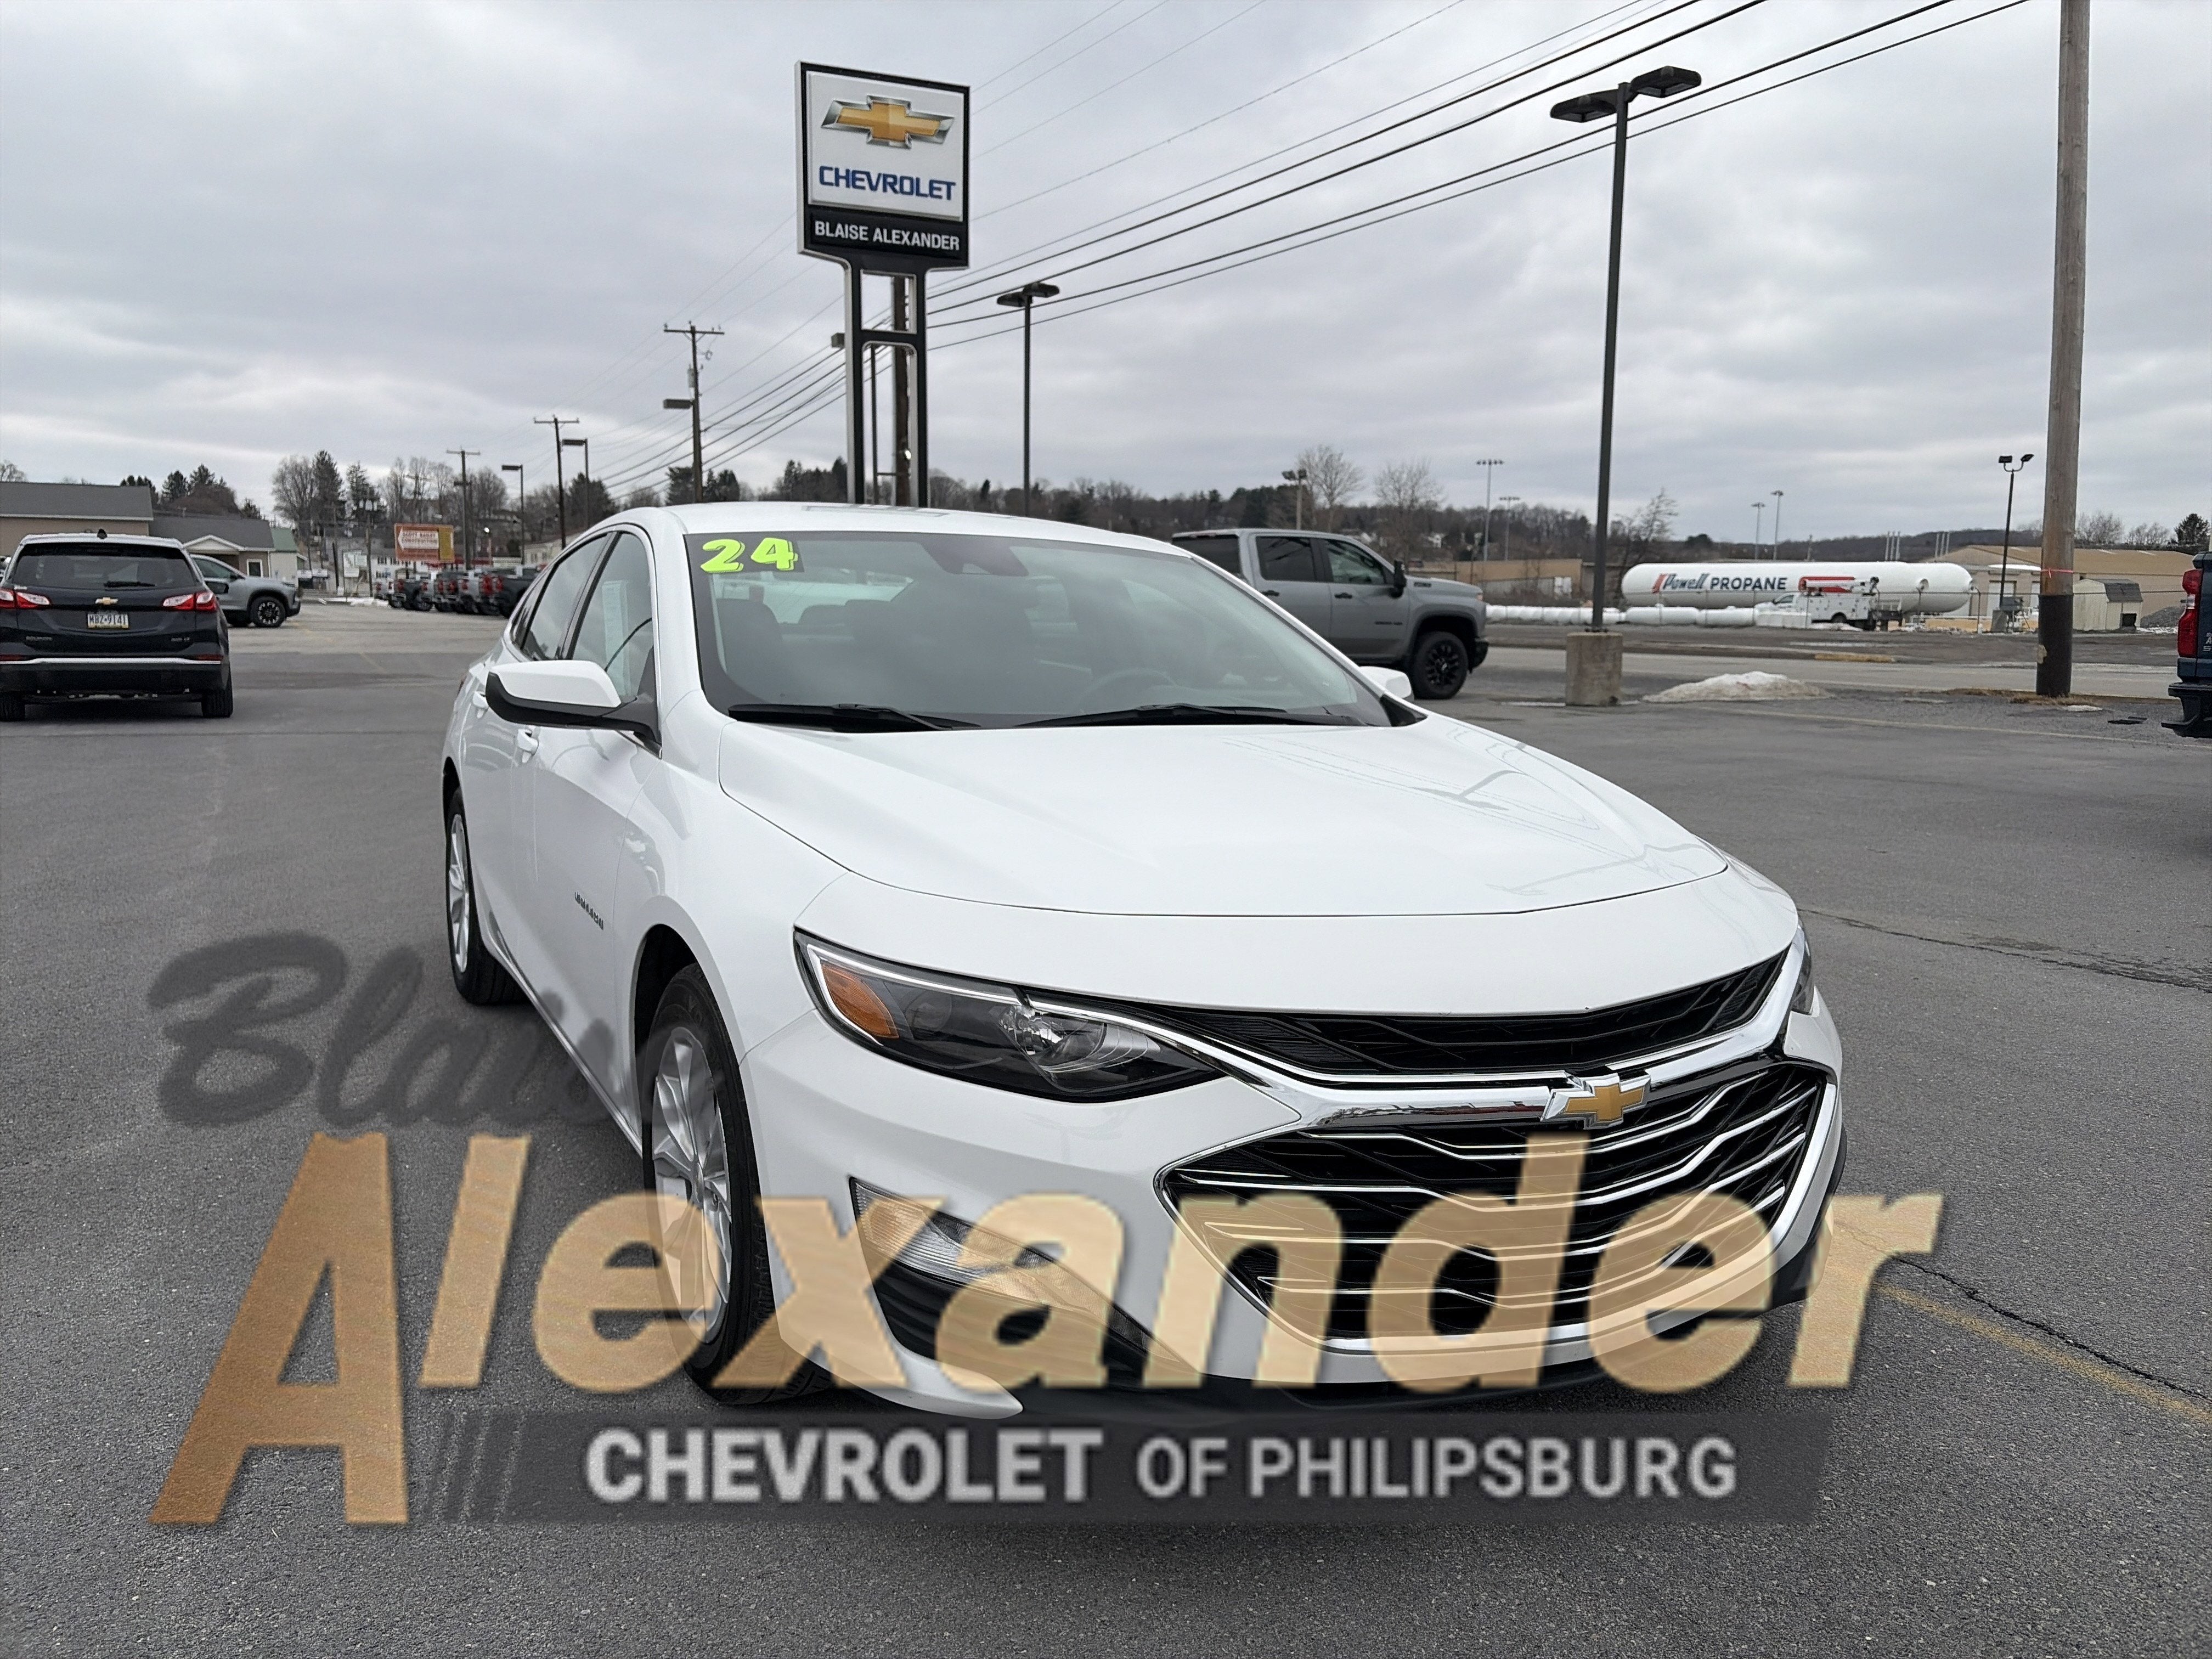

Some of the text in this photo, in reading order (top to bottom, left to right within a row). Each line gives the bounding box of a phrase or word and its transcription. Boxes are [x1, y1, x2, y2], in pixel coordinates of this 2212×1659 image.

[819, 165, 956, 201] CHEVROLET
[815, 221, 960, 251] BLAISE ALEXANDER
[700, 537, 798, 572] 24
[1657, 573, 1787, 591] Powell PROPANE
